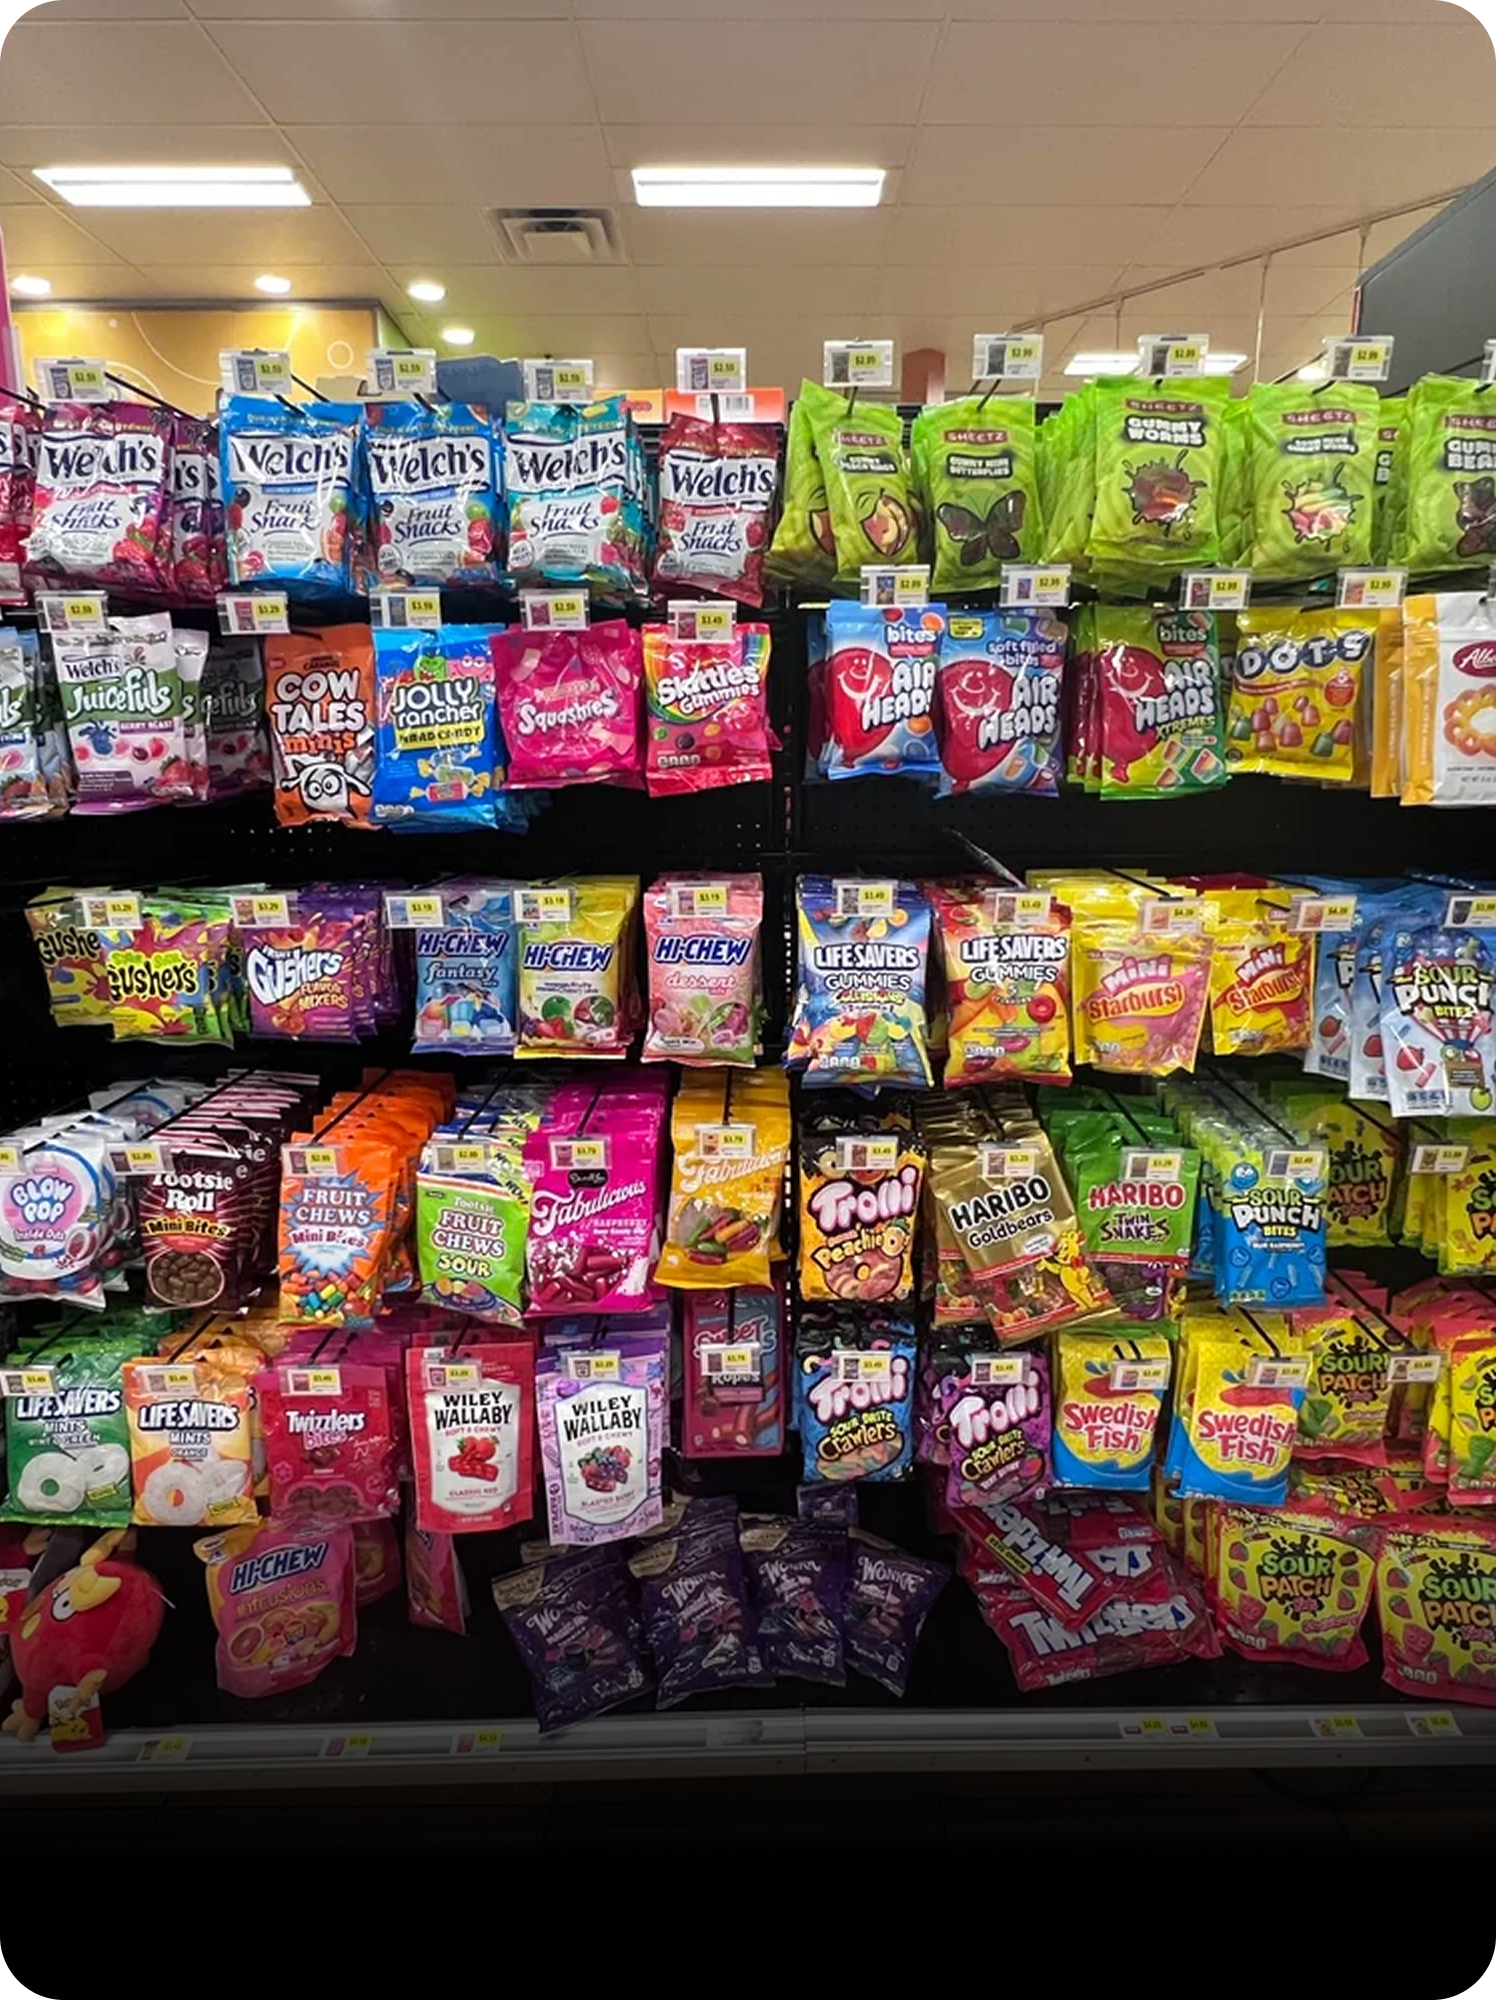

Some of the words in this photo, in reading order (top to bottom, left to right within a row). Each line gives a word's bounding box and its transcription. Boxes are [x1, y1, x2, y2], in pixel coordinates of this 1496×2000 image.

[1129, 400, 1200, 413] SHEETZ
[1286, 410, 1353, 424] SHEETZ
[947, 431, 1005, 443] SHEETZ
[1127, 417, 1202, 434] GUMMY
[1127, 429, 1203, 444] WORMS
[234, 438, 348, 477] Welch's
[372, 440, 486, 484] Welch's
[512, 438, 627, 484] Welch's
[670, 463, 772, 498] Welch's
[407, 501, 456, 521] Fruit
[543, 502, 591, 520] Fruit
[395, 519, 462, 542] Snacks
[679, 533, 742, 552] Snacks
[692, 520, 737, 539] Fruit
[887, 625, 936, 643] bites
[1158, 624, 1206, 642] bites
[988, 641, 1018, 656] soft
[65, 655, 121, 680] Welch's
[893, 660, 936, 692] AIR
[1165, 660, 1214, 688] AIR
[66, 668, 172, 720] Juicefuls
[276, 669, 361, 702] COW
[393, 678, 478, 714] JOLLY
[657, 664, 760, 706] Skittles
[1014, 675, 1059, 707] AIR
[679, 684, 760, 716] Gummies
[1136, 687, 1216, 730] HEADS
[271, 700, 365, 733] TALES
[397, 702, 483, 728] rancher
[519, 692, 617, 736] Squashies
[978, 703, 1057, 749] HEADS
[1156, 714, 1216, 740] XTREMES
[282, 732, 356, 755] minis
[418, 933, 508, 958] HI-CHEW
[523, 944, 611, 971] HI-CHEW
[654, 936, 753, 963] HI-CHEW
[815, 947, 854, 968] LIFE
[854, 944, 919, 969] SAVERS
[962, 939, 1002, 962] LIFE
[1001, 935, 1068, 961] SAVERS
[107, 960, 197, 1002] Gushers
[249, 949, 345, 1006] Gushers
[424, 961, 496, 982] fantasy
[665, 971, 737, 990] dessert
[824, 973, 912, 992] GUMMIES
[970, 966, 1059, 983] GUMMIES
[1417, 963, 1478, 984] SOUR
[302, 981, 342, 996] FLAVOR
[1088, 983, 1183, 1020] Starburst
[1229, 971, 1301, 1012] Starburst
[300, 994, 348, 1012] MIXERS
[12, 1176, 74, 1204] BLOW
[153, 1171, 234, 1191] Tootsie
[165, 1189, 216, 1212] Roll
[302, 1189, 367, 1208] FRUIT
[532, 1180, 647, 1237] Fabulicious
[811, 1166, 918, 1231] Trolli
[950, 1176, 1050, 1232] HARIBO
[1088, 1182, 1186, 1209] HARIBO
[1250, 1189, 1301, 1206] SOUR
[23, 1200, 66, 1223] POP
[295, 1207, 371, 1225] CHEWS
[440, 1210, 504, 1235] FRUIT
[1114, 1213, 1151, 1226] TWIN
[1232, 1203, 1321, 1230] PUNCH
[149, 1217, 183, 1235] Mini
[184, 1217, 229, 1237] Bites
[291, 1228, 333, 1245] Mini
[968, 1210, 1055, 1249] Goldbears
[1101, 1219, 1172, 1243] SNAKES
[1263, 1225, 1297, 1237] BITES
[431, 1230, 504, 1257] CHEWS
[816, 1230, 884, 1271] Peachie
[437, 1256, 492, 1277] SOUR
[1321, 1356, 1387, 1373] SOUR
[809, 1357, 908, 1423] Trolli
[1320, 1373, 1387, 1392] PATCH
[51, 1387, 121, 1414] SAVERS
[443, 1390, 504, 1408] WILEY
[571, 1394, 633, 1418] WILEY
[948, 1370, 1040, 1449] Trolli
[139, 1404, 177, 1428] LIFE
[177, 1402, 239, 1429] SAVERS
[286, 1408, 366, 1433] Twizzlers
[434, 1403, 513, 1431] WALLABY
[563, 1407, 643, 1442] WALLABY
[1063, 1402, 1160, 1434] Swedish
[1197, 1409, 1297, 1443] Swedish
[169, 1432, 212, 1445] MINTS
[818, 1421, 897, 1460] Crawlers
[830, 1421, 860, 1438] SOUR
[1086, 1425, 1141, 1452] Fish
[960, 1440, 1026, 1481] Crawlers
[1218, 1434, 1277, 1465] Fish
[229, 1542, 329, 1594] HI-CHEW
[1261, 1552, 1333, 1577] SOUR
[1260, 1575, 1335, 1601] PATCH
[1424, 1574, 1496, 1601] SOUR
